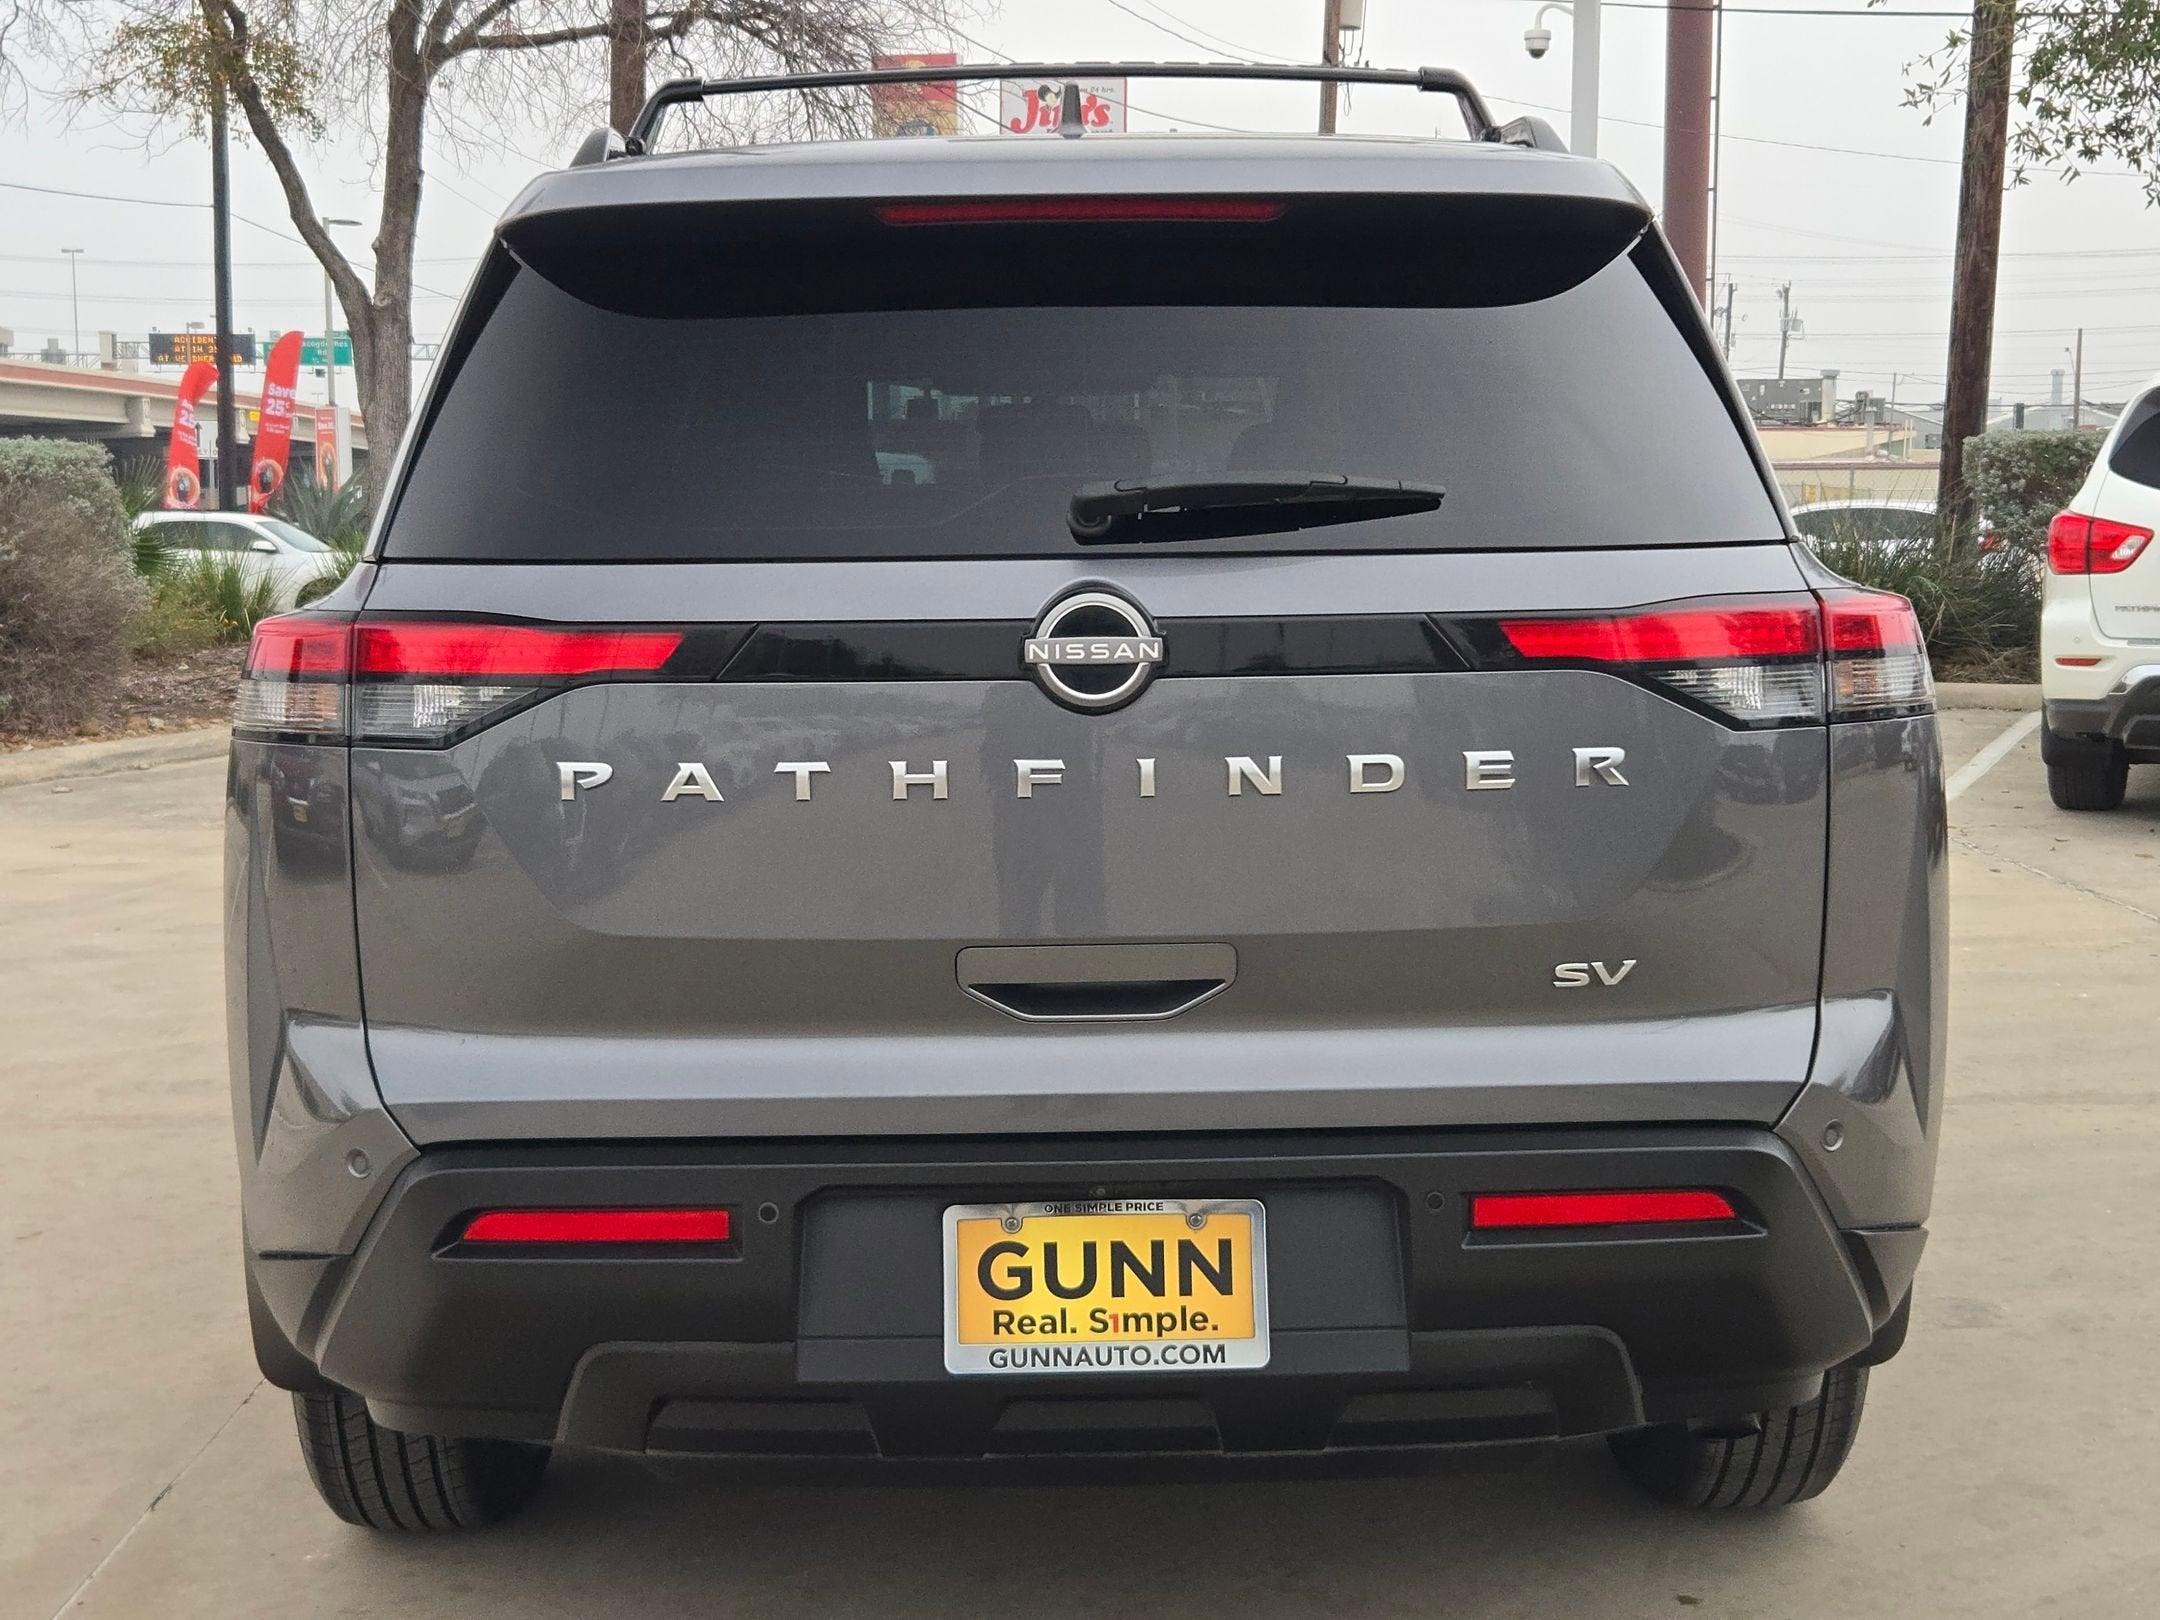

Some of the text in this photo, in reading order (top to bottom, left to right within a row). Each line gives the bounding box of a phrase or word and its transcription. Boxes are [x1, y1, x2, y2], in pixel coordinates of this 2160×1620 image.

[268, 383, 297, 399] Save
[1029, 642, 1159, 660] NISSAN
[556, 747, 1629, 801] PATHFINDER
[1553, 960, 1637, 987] SV
[1044, 1201, 1164, 1214] ONE SIMPLE PRICE
[977, 1238, 1234, 1300] GUNN
[993, 1307, 1077, 1336] Real.
[988, 1343, 1226, 1369] GUNNAUTO.COM
